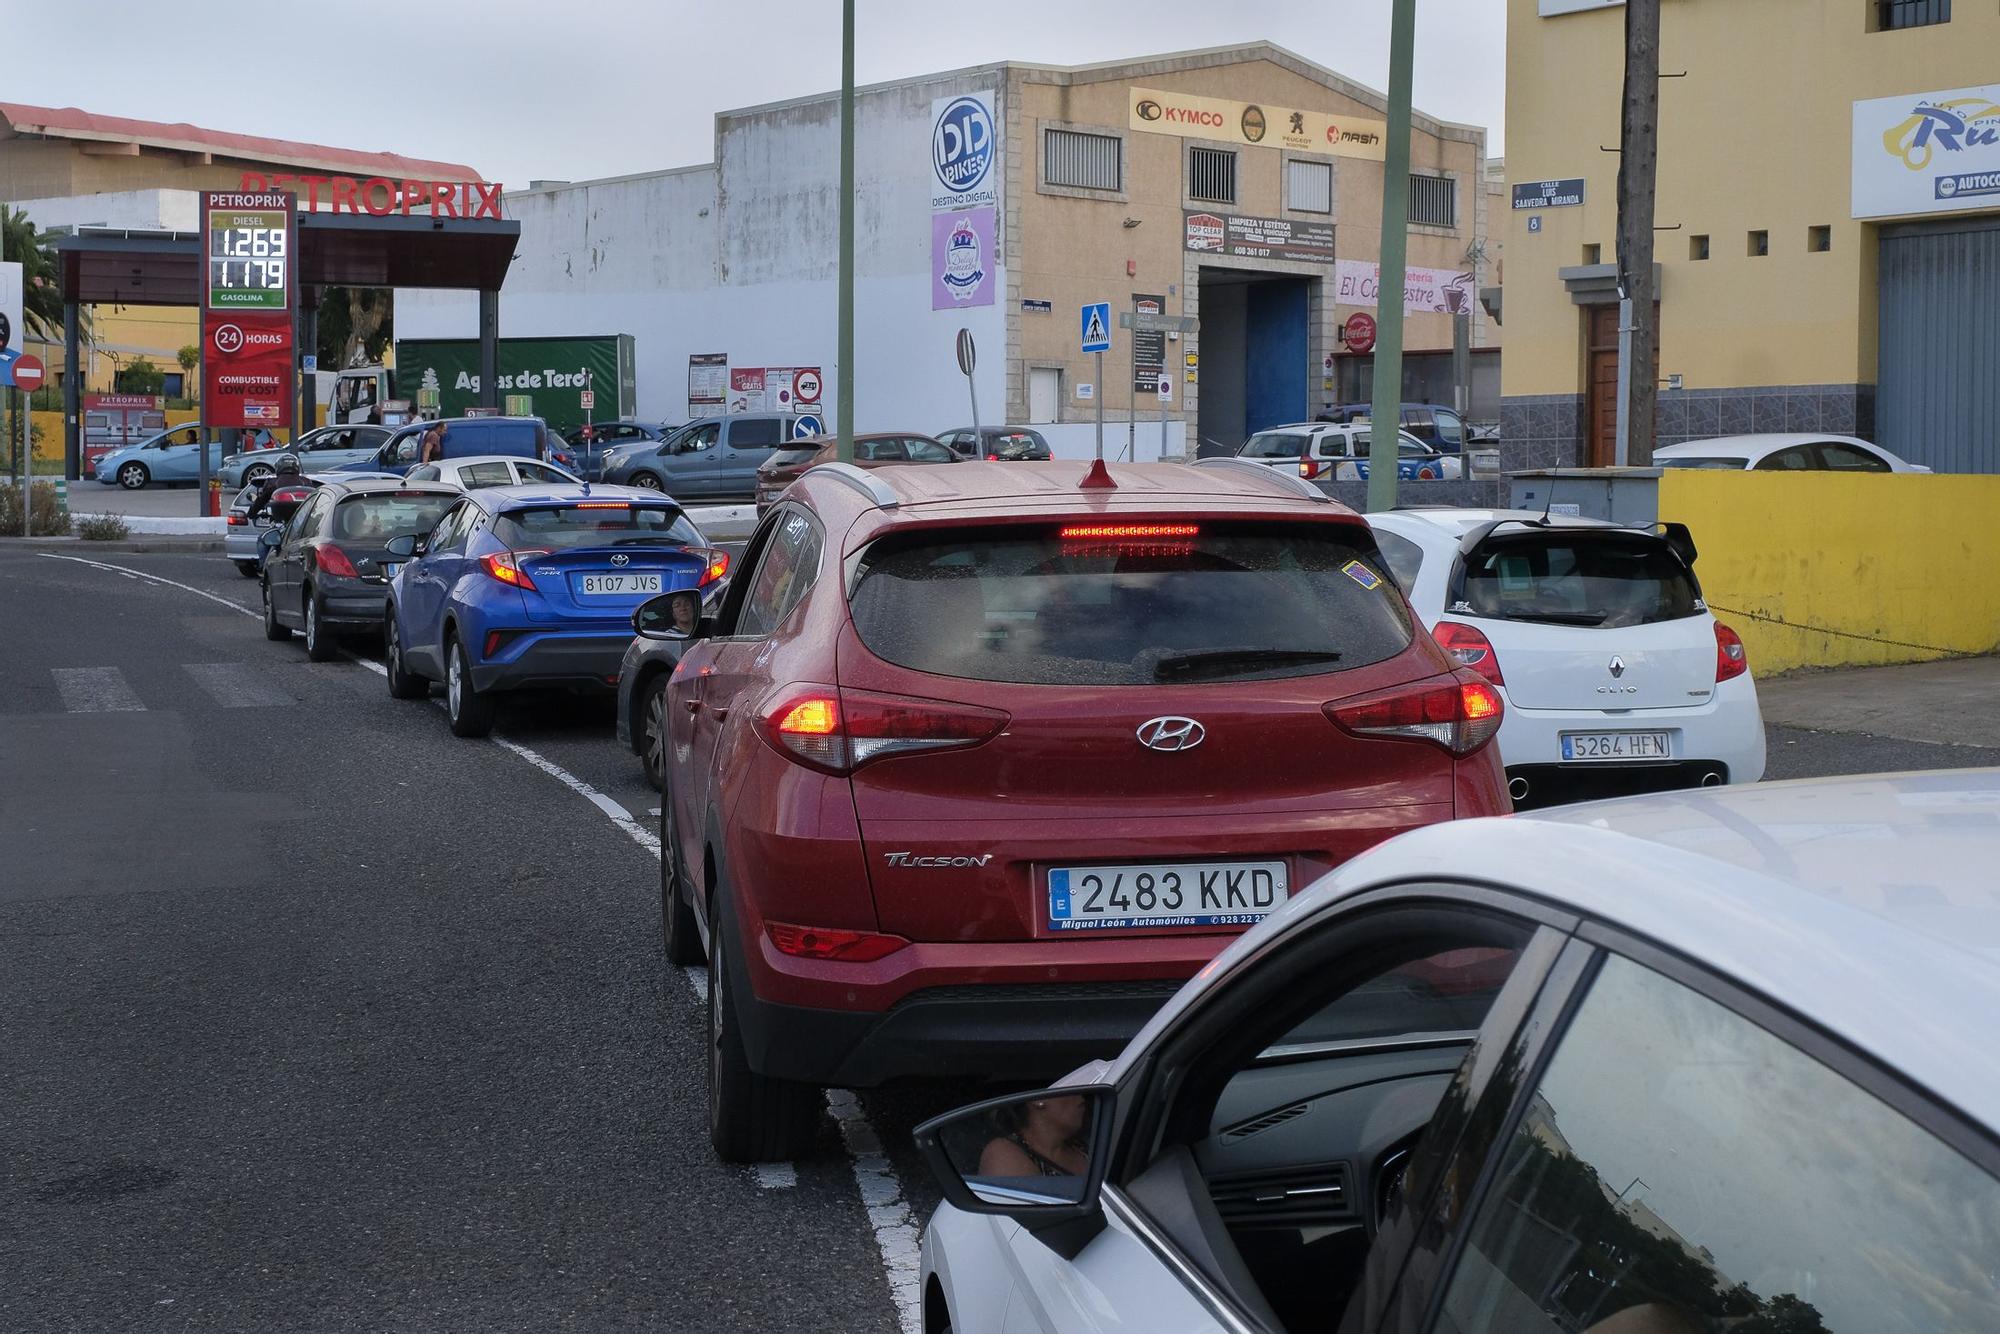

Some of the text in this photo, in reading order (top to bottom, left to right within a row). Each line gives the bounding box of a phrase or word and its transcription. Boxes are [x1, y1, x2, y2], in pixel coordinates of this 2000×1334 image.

[1918, 100, 1967, 119] AUTO
[1165, 107, 1223, 127] KYMCO
[1282, 136, 1312, 144] PEUGEOT
[945, 155, 985, 182] BIKES
[932, 191, 994, 206] DESTINO DIGITAL
[1542, 188, 1557, 197] LUIS
[210, 194, 286, 207] PETROPRIX
[1515, 195, 1579, 208] SAAVEDRA MIRANDA
[233, 216, 265, 226] DIESEL
[1228, 217, 1291, 230] LIMPIEZA Y ESTÉTICA
[1530, 218, 1538, 229] 8
[1203, 227, 1222, 235] CLEAR
[1228, 225, 1254, 234] INTEGRAL
[1263, 228, 1291, 237] VEHÍCULOS
[224, 229, 286, 257] 1.269
[1235, 246, 1270, 257] 608 361 017
[222, 260, 283, 288] 1.179
[1340, 277, 1356, 297] El
[220, 294, 263, 302] GASOLINA
[220, 332, 282, 344] 24 HORAS
[218, 376, 280, 384] COMBUSTIBLE
[454, 371, 513, 393] Agas
[516, 371, 541, 388] de
[219, 386, 279, 395] LOW COST
[585, 577, 659, 591] 8107 JVS
[1596, 686, 1637, 694] CLIO
[1575, 735, 1665, 756] 5264 HFN
[1081, 869, 1275, 913] 2483 KKD
[1056, 899, 1066, 910] E
[1061, 919, 1098, 930] Miguel
[1101, 919, 1126, 928] León
[1131, 916, 1196, 926] Automóviles
[1220, 916, 1238, 924] 928
[1240, 915, 1252, 923] 22
